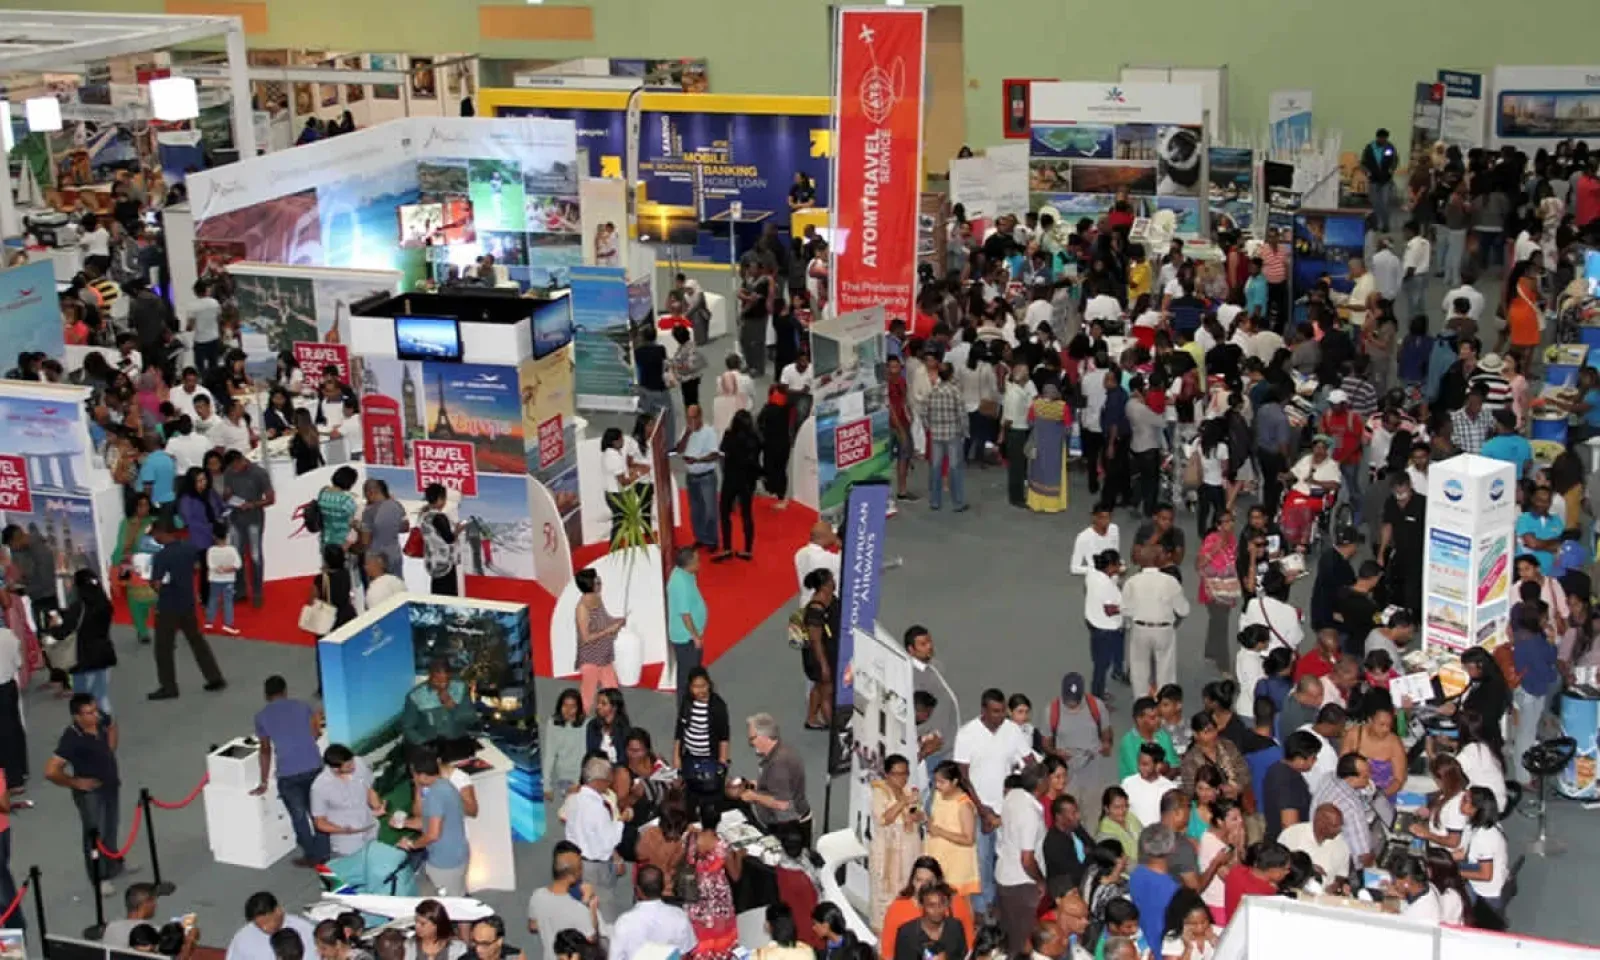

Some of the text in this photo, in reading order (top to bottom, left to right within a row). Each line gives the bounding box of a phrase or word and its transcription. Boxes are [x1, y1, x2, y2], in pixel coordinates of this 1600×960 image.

[683, 152, 728, 164] MOBILE
[879, 128, 891, 184] SERVICE
[703, 165, 757, 177] BANKING
[704, 177, 736, 187] HOME
[737, 178, 767, 189] LOAN
[862, 129, 880, 268] ATOMTRAVEL
[841, 281, 909, 292] The Preferred
[841, 293, 909, 307] Travel Agency
[298, 347, 341, 362] TRAVEL
[300, 361, 346, 376] ESCE
[838, 423, 869, 441] TRAVEL
[839, 435, 869, 453] ESCAPE
[417, 445, 466, 461] TRAVEL
[839, 448, 866, 465] ENJOY
[420, 459, 470, 477] ESCAPE
[848, 502, 869, 636] OUTH AFRICAN
[861, 532, 876, 602] AIRWAYS
